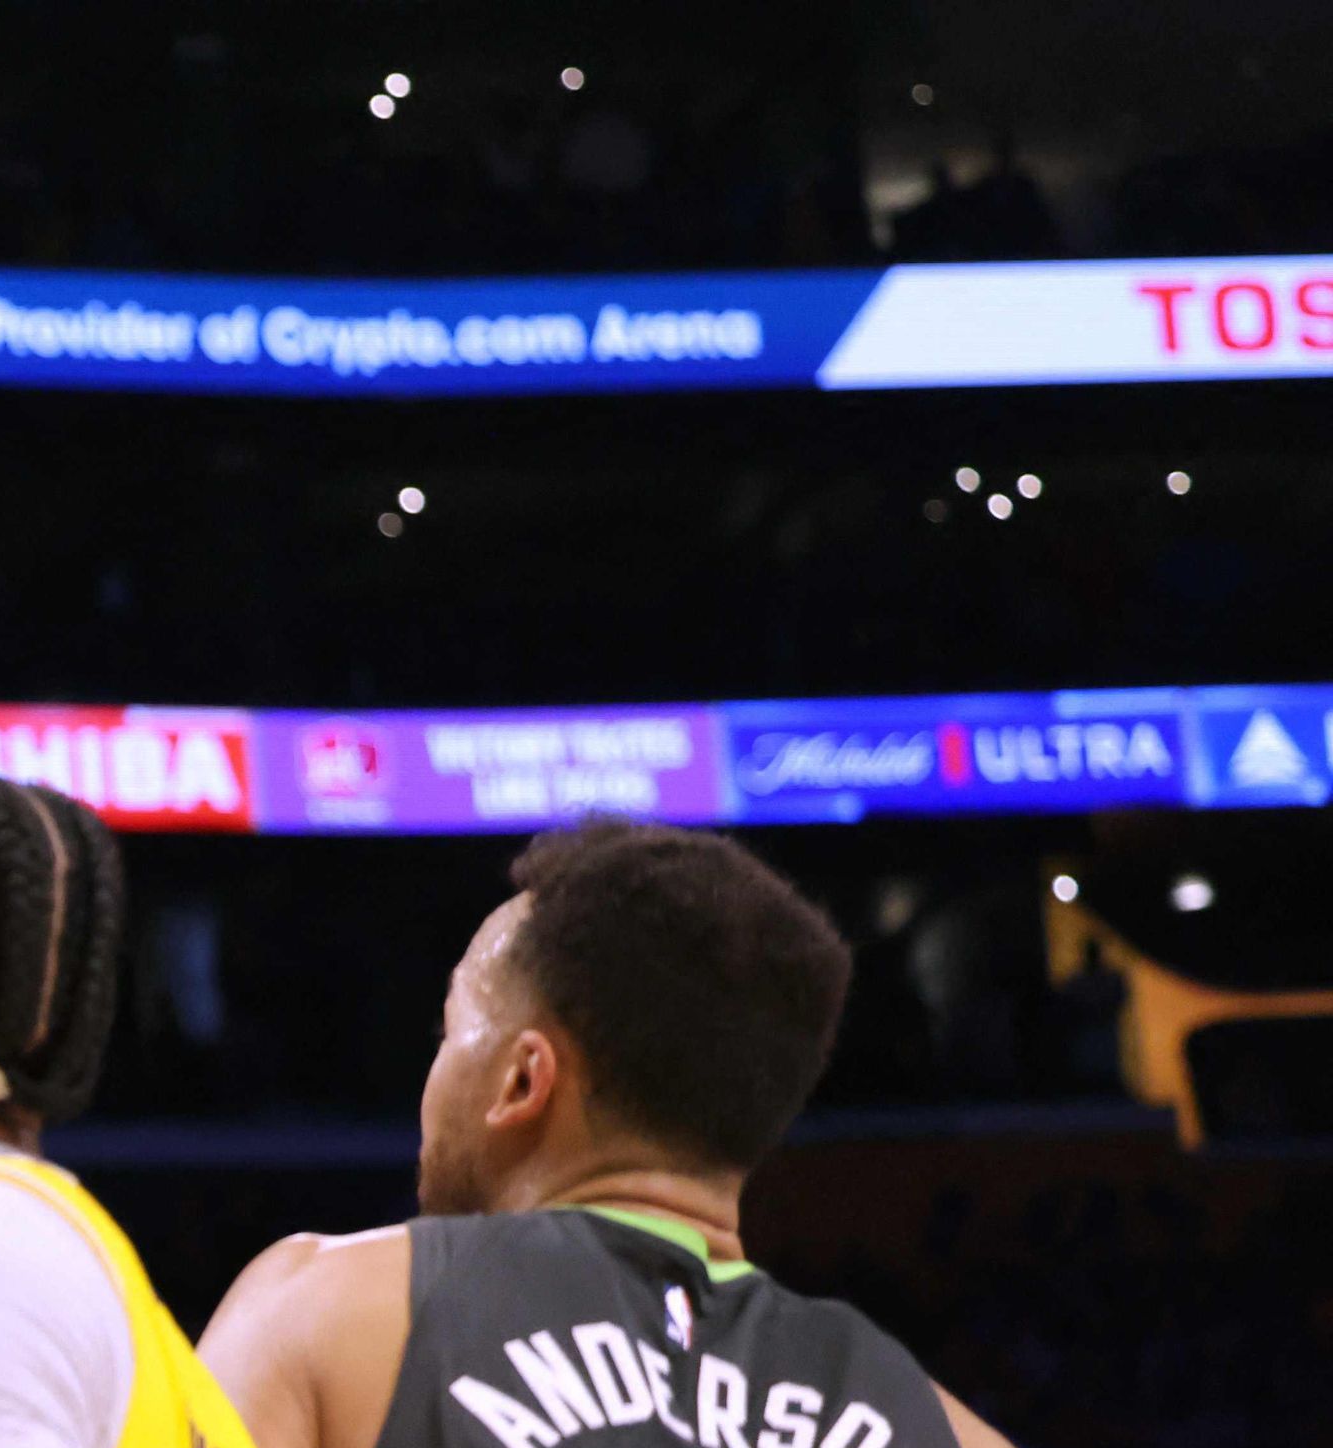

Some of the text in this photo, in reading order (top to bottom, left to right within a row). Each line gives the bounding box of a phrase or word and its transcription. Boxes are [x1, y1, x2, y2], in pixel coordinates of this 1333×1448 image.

[197, 303, 260, 365] of
[261, 305, 588, 377] Crypto.com
[589, 302, 765, 363] Arena
[973, 721, 1173, 784] ULTRA
